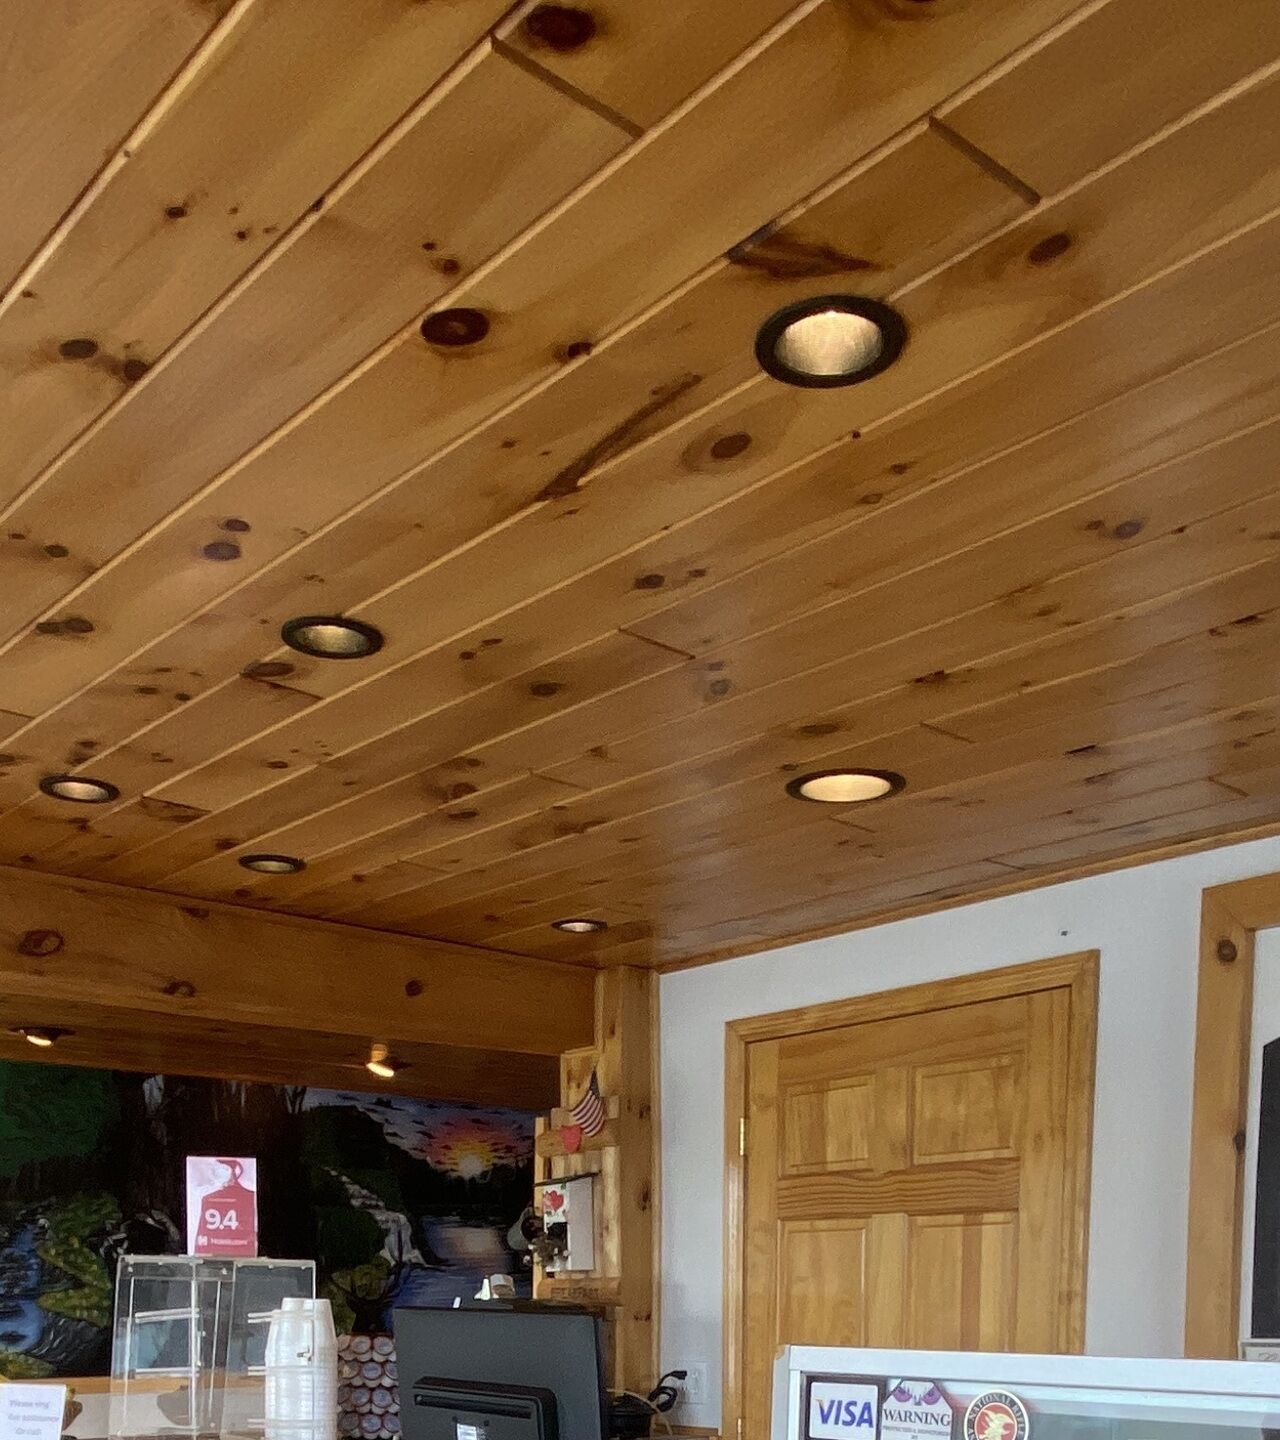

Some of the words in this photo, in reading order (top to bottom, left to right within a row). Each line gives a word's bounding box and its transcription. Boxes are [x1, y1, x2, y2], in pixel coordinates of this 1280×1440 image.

[205, 1208, 239, 1230] 9.4
[815, 1399, 874, 1429] VISA
[883, 1409, 951, 1427] WARNING
